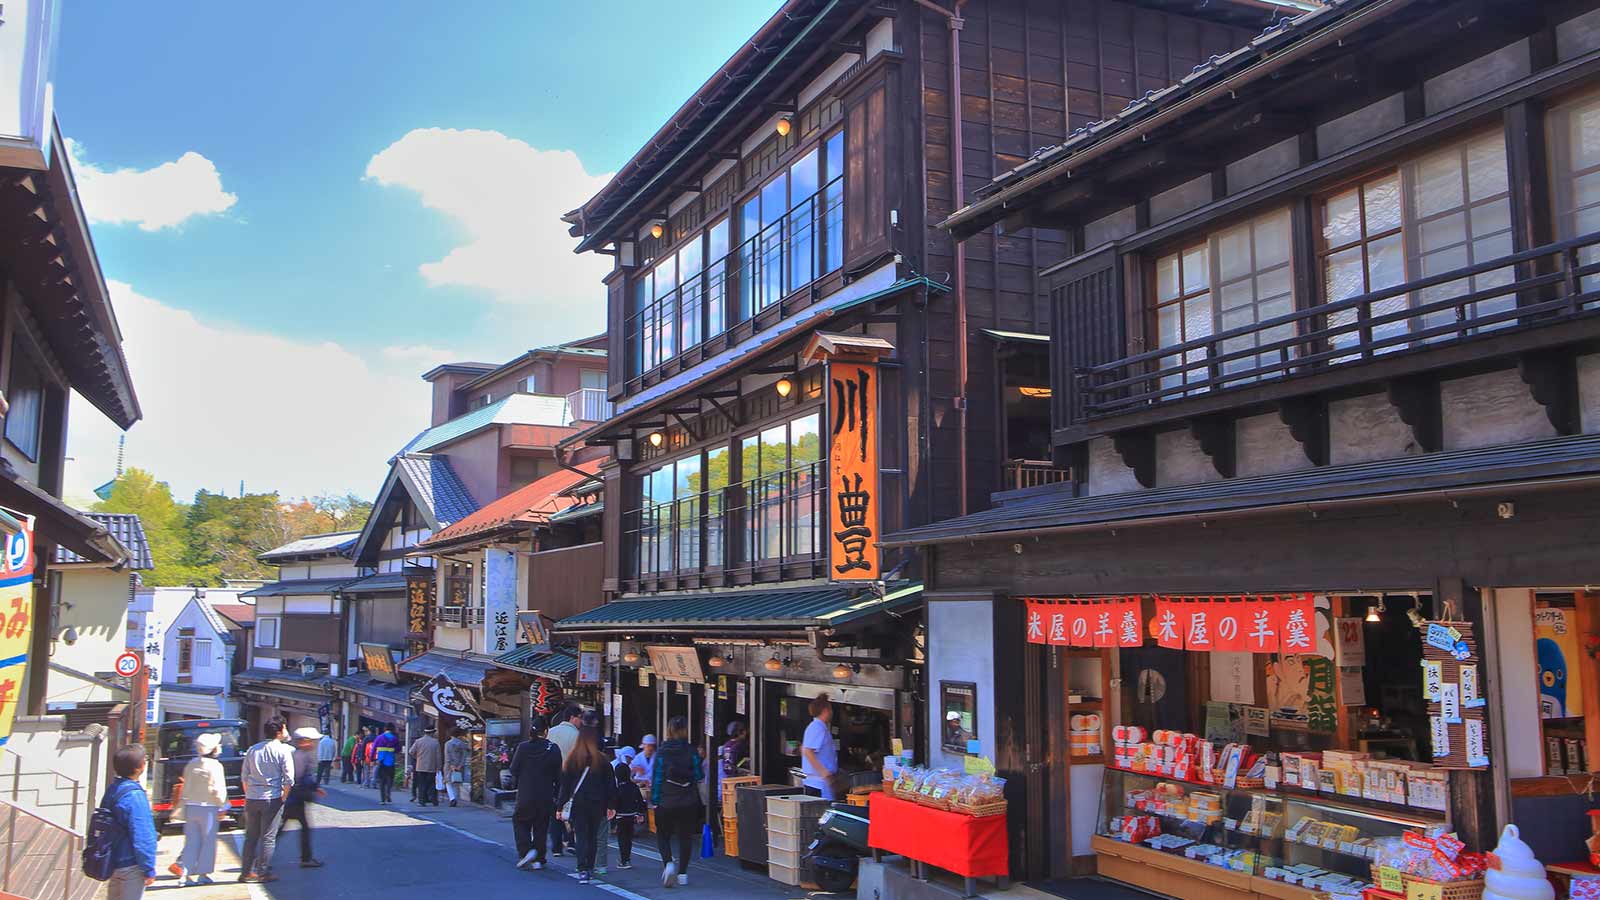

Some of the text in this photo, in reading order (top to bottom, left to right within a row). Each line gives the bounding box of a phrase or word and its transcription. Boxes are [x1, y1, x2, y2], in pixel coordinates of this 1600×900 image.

[832, 368, 872, 574] 川豊
[410, 589, 428, 633] 近江屋
[495, 611, 509, 651] 近江屋
[1027, 610, 1139, 643] 米屋の羊羹
[1158, 608, 1312, 649] 米屋の羊羹
[121, 660, 136, 670] 20
[1444, 689, 1454, 719] バニラ
